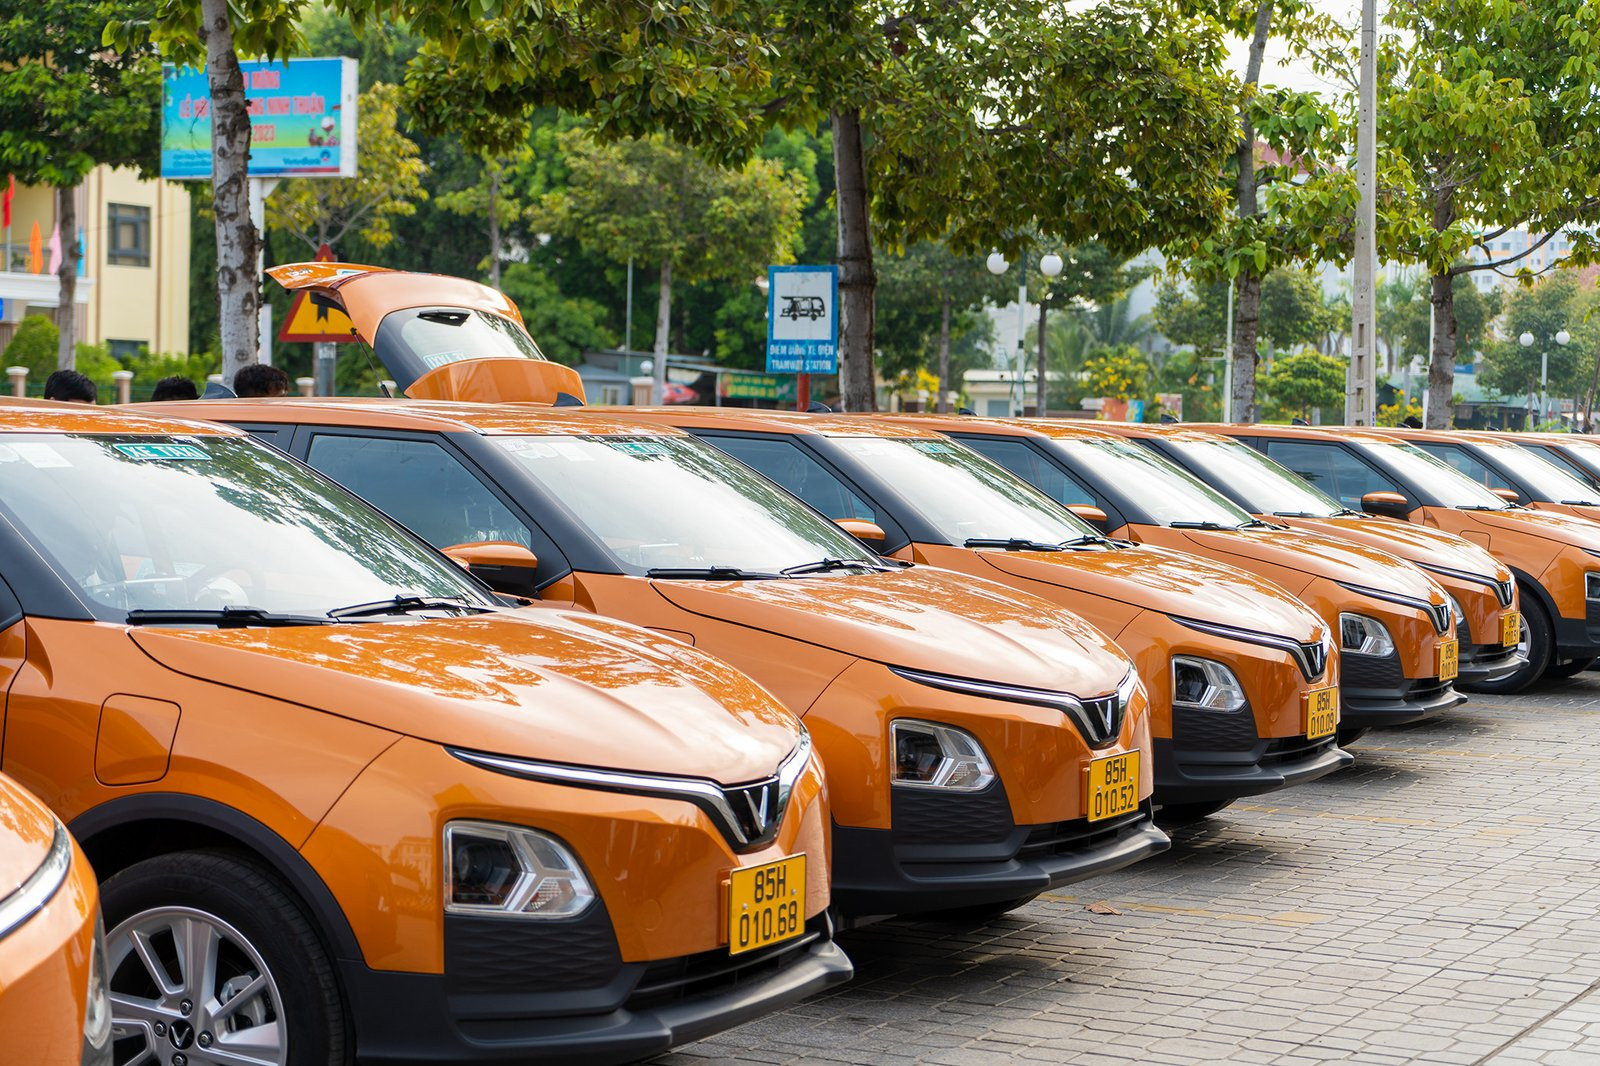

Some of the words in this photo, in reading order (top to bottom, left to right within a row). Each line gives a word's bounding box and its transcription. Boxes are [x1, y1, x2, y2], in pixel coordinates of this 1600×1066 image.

[252, 124, 275, 142] 2023
[1317, 690, 1330, 712] 85H
[1105, 757, 1127, 785] 85H
[1095, 784, 1134, 817] 010.52
[754, 864, 786, 903] 85H
[739, 900, 797, 947] 010.68
